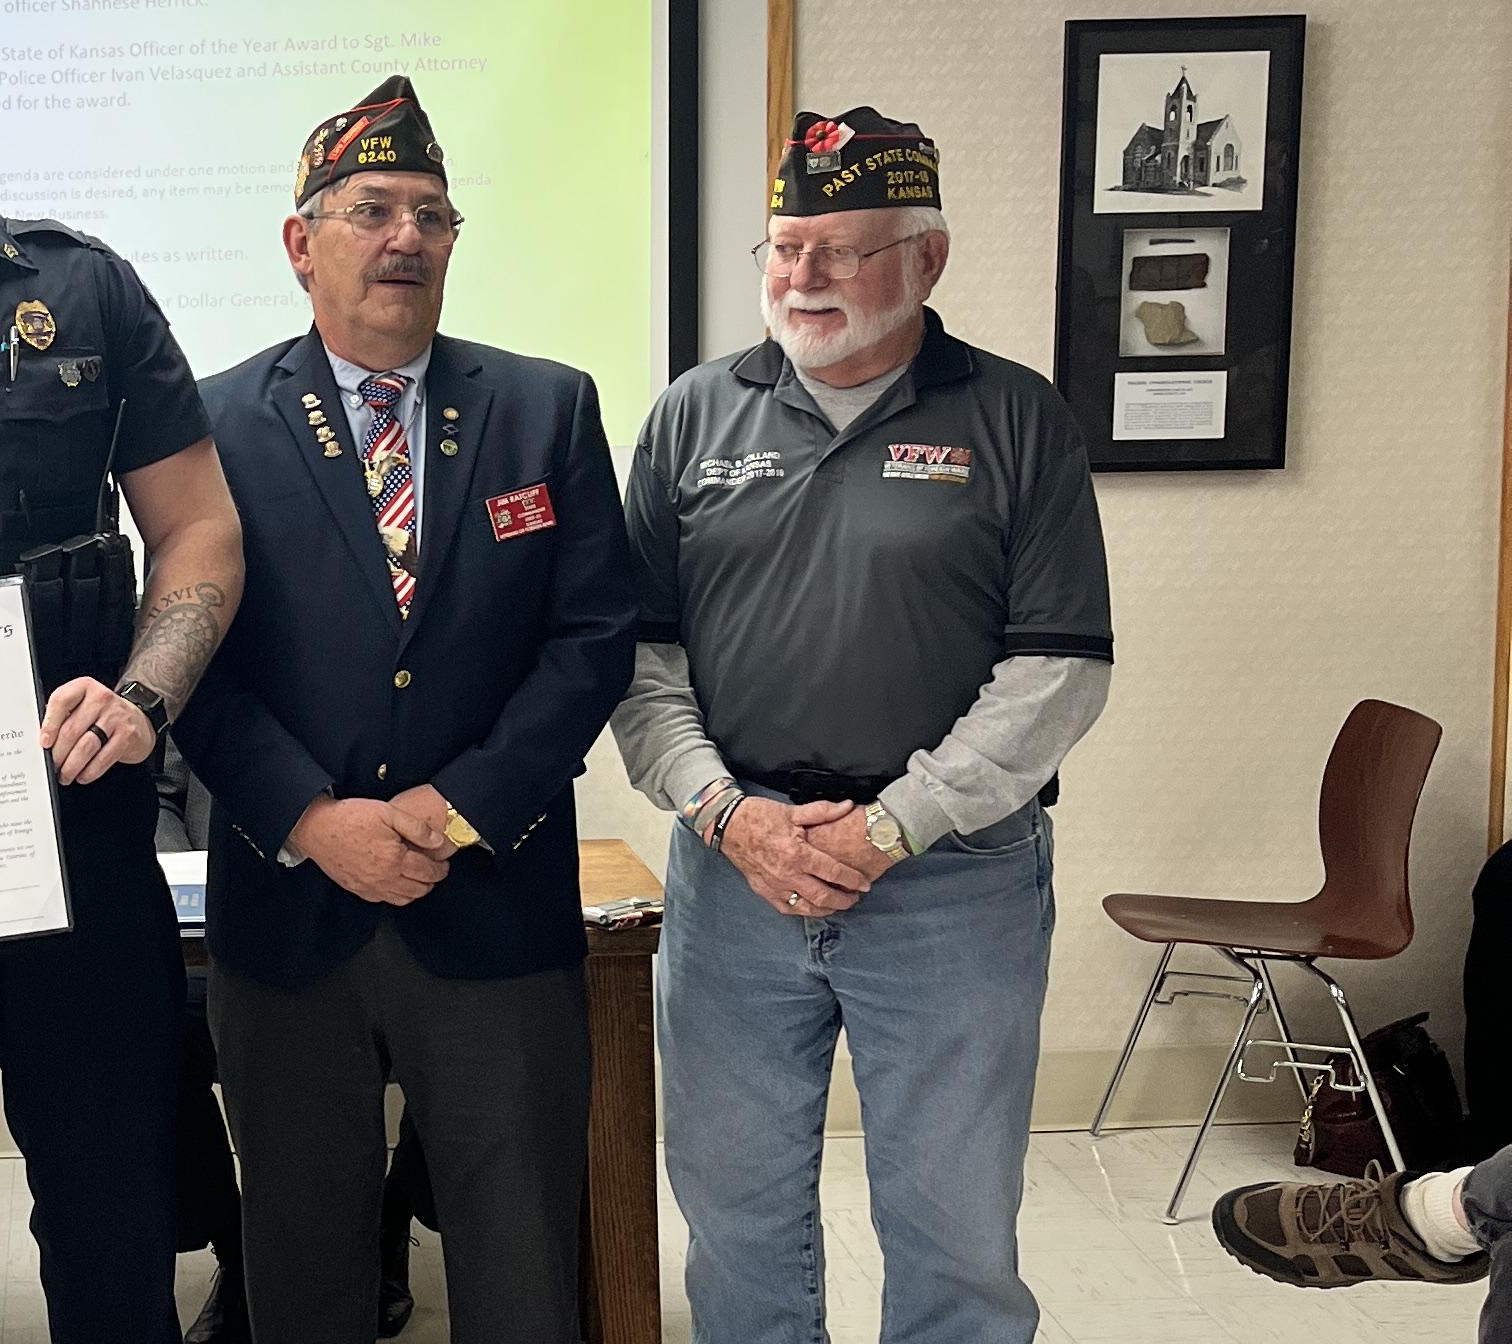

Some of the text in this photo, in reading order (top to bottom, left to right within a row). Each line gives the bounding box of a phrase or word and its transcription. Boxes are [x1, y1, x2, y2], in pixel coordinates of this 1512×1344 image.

[1, 46, 43, 62] State
[48, 43, 66, 60] of
[69, 44, 125, 60] Kansas
[130, 41, 185, 58] Officer
[189, 39, 207, 56] of
[211, 38, 238, 54] the
[243, 38, 278, 54] Year
[284, 35, 337, 52] Award
[342, 34, 359, 49] to
[364, 33, 394, 52] Sgt.
[401, 32, 441, 47] Mike
[51, 67, 105, 84] Officer
[111, 67, 145, 83] Ivan
[149, 64, 231, 84] Velasquez
[237, 62, 267, 78] and
[272, 59, 345, 77] Assistant
[351, 57, 409, 76] County
[414, 55, 488, 73] Attorney
[17, 94, 40, 111] for
[45, 93, 71, 110] the
[76, 91, 131, 109] award.
[360, 136, 392, 151] VFW
[358, 150, 397, 164] 6240
[43, 171, 65, 182] are
[68, 166, 141, 181] considered
[146, 165, 185, 179] under
[188, 166, 214, 177] one
[218, 163, 266, 176] motion
[270, 161, 294, 174] and
[822, 162, 862, 198] PAST
[865, 148, 905, 172] STATE
[0, 188, 68, 202] discussion
[71, 188, 81, 199] is
[84, 186, 138, 201] desired,
[141, 187, 165, 200] any
[170, 184, 198, 197] item
[203, 185, 231, 199] may
[236, 182, 253, 195] be
[256, 182, 295, 195] remo
[451, 174, 492, 188] genda
[887, 185, 934, 200] KANSAS
[124, 246, 249, 263] utes as written.
[178, 293, 226, 309] Dollar
[230, 290, 300, 309] General,
[888, 444, 951, 464] VFW
